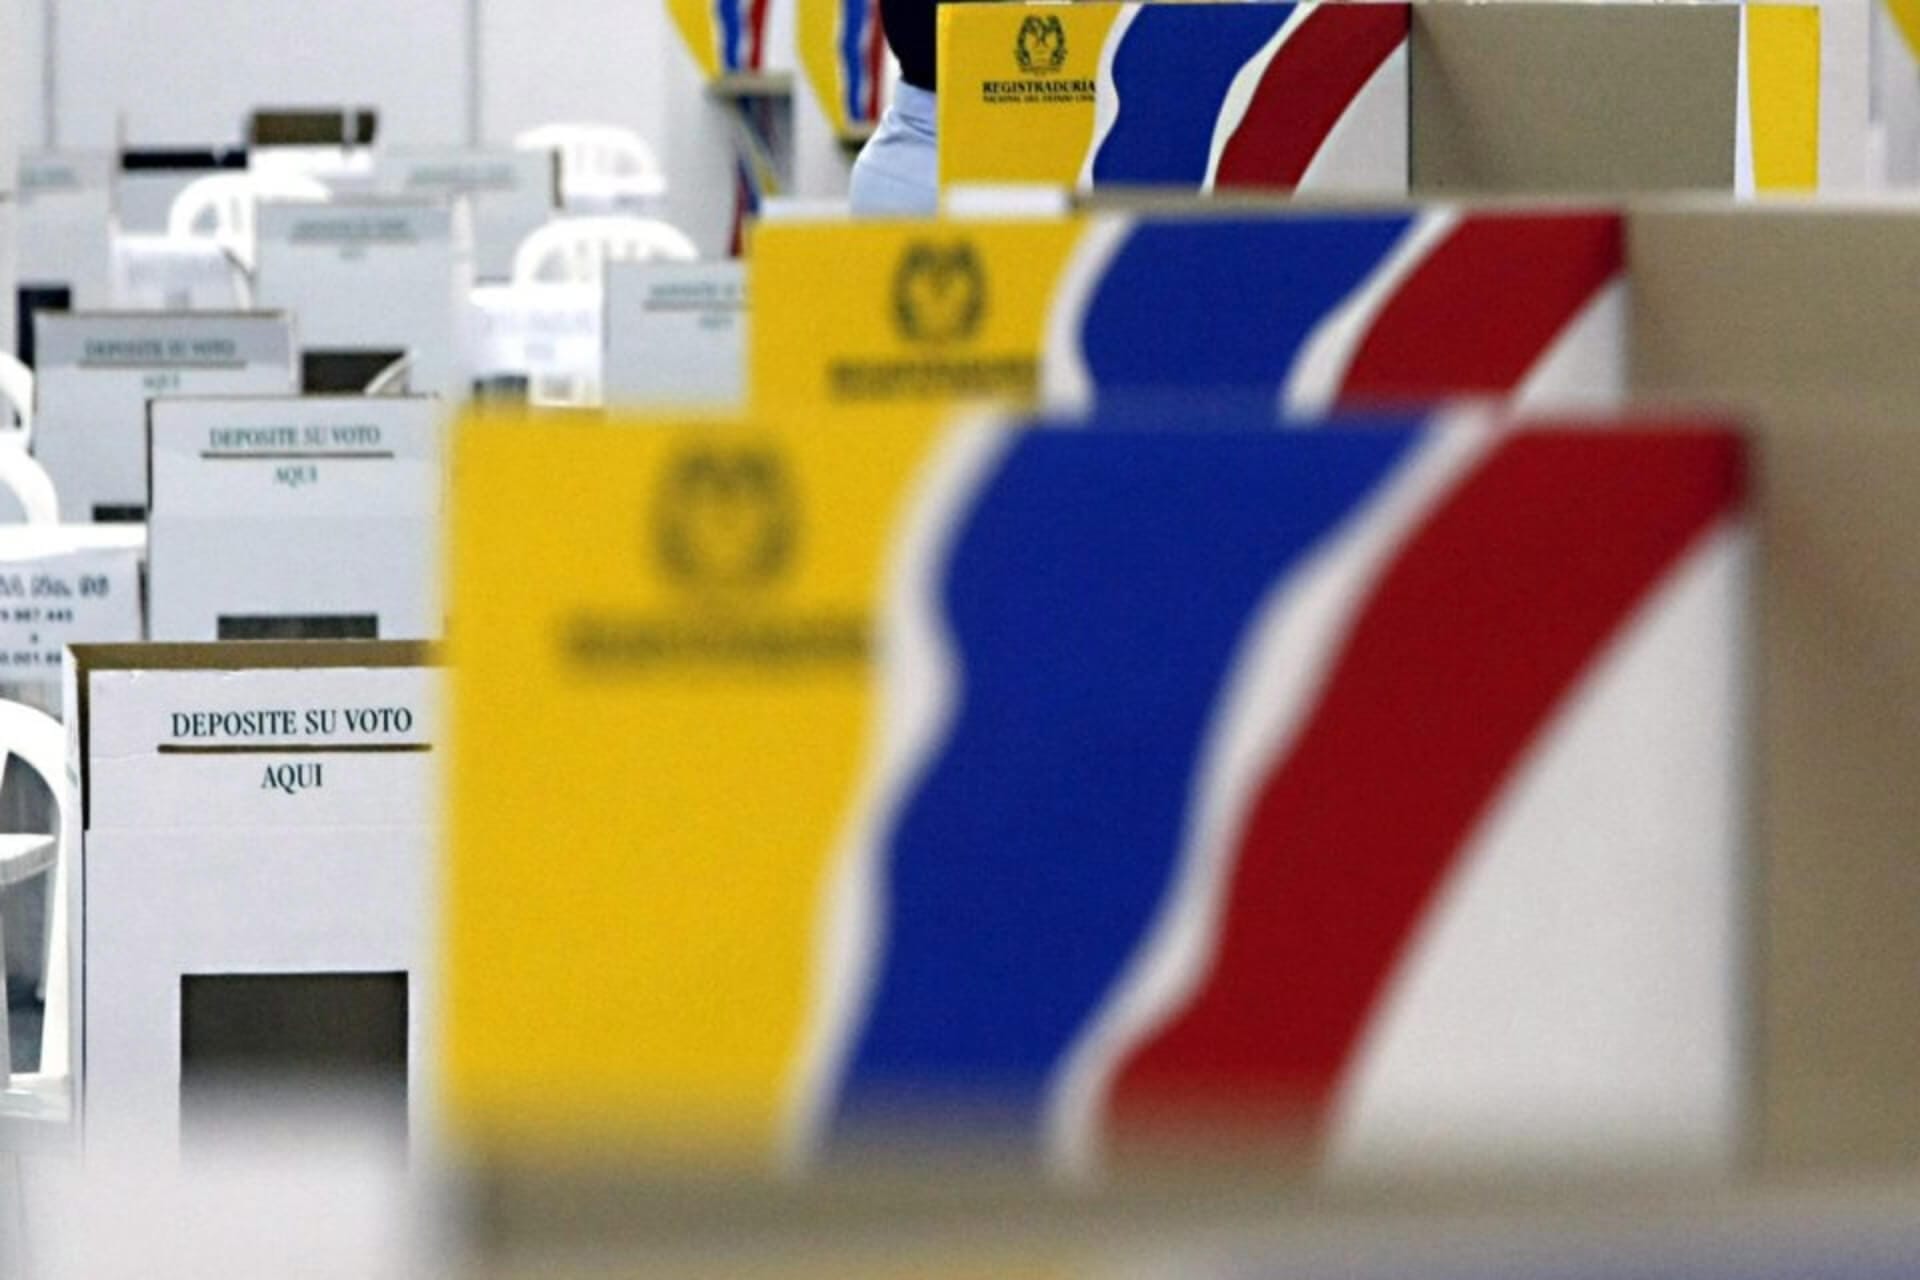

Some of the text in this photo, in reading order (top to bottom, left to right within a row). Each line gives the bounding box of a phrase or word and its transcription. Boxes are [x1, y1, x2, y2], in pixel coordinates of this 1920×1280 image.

[209, 425, 381, 447] DEPOSITE SU VOTO
[276, 466, 318, 488] AQUI
[171, 706, 413, 738] DEPOSITE SU VOTO
[261, 762, 323, 795] AQUI
